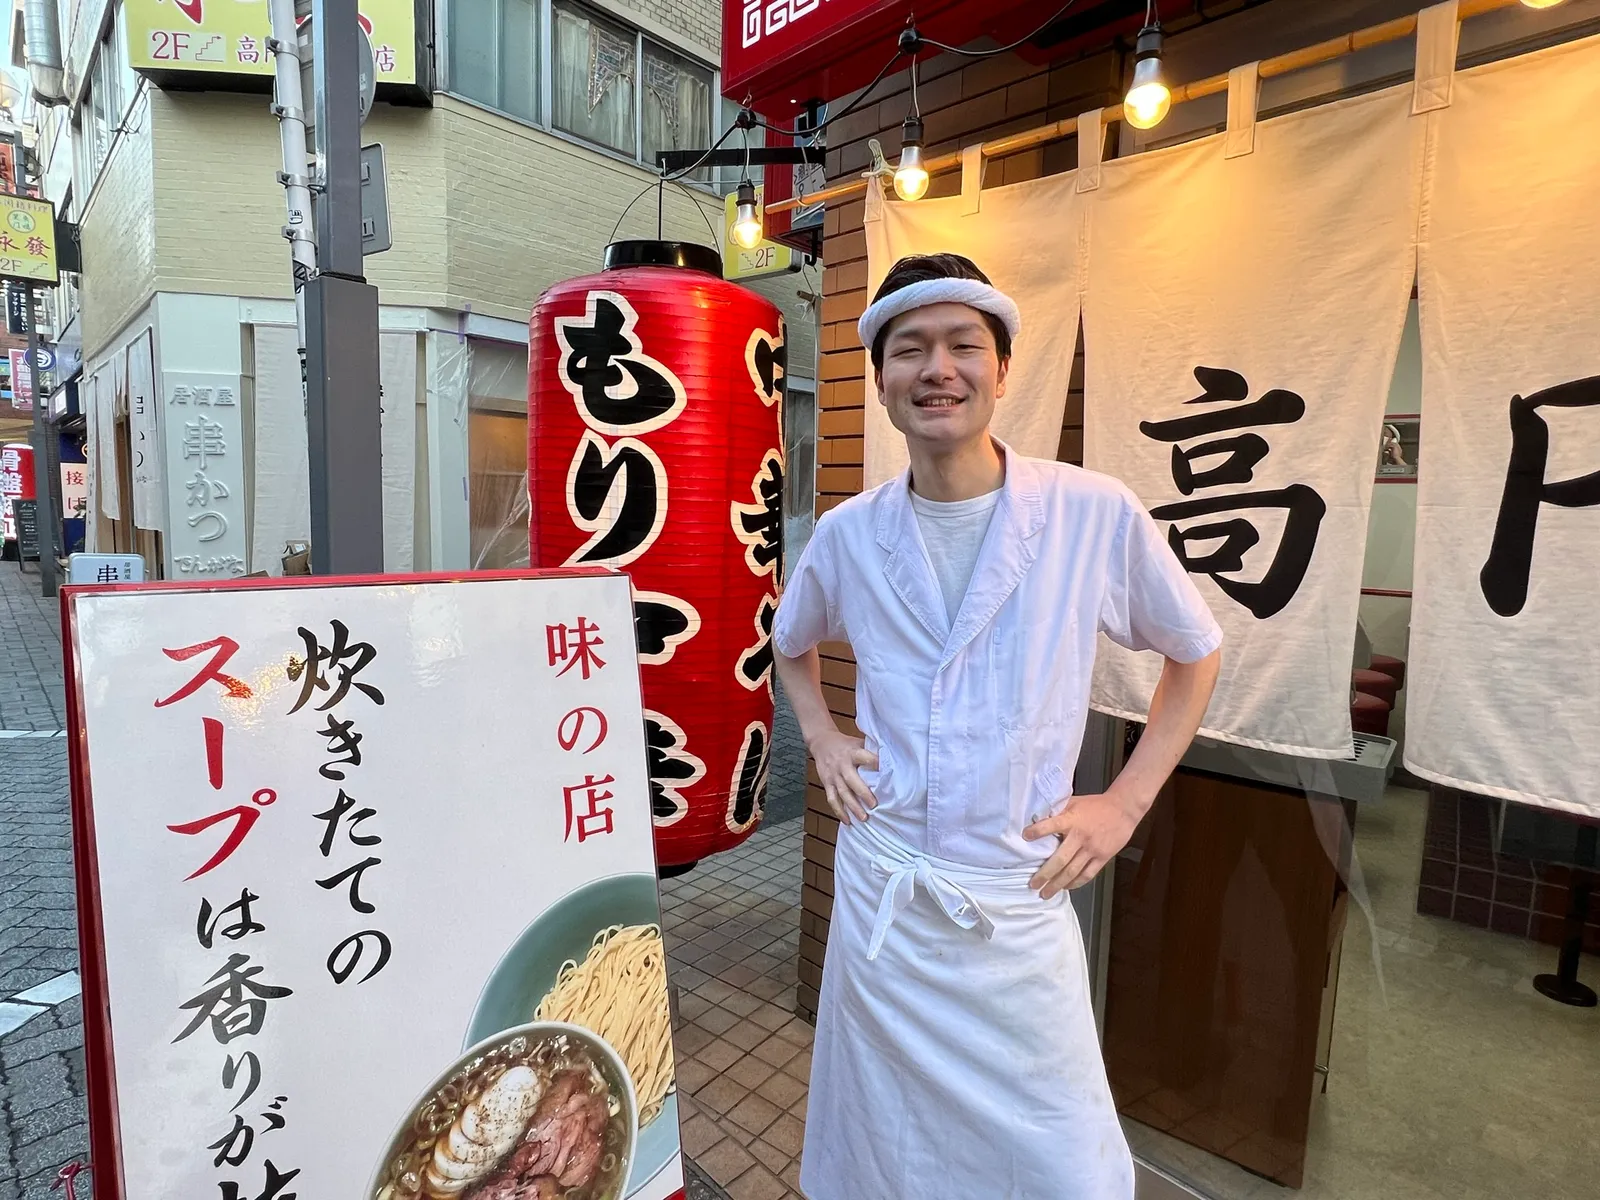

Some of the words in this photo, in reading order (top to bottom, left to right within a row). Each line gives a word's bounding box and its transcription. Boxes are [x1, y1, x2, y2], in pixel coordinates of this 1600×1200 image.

[152, 31, 191, 60] 2F
[237, 36, 396, 72] 高店
[1, 258, 22, 272] 2F
[755, 247, 776, 268] 2F
[169, 384, 236, 406] 居酒屋
[183, 414, 230, 542] 串かつ
[546, 617, 614, 844] 味の店
[287, 619, 392, 985] 炊きたての
